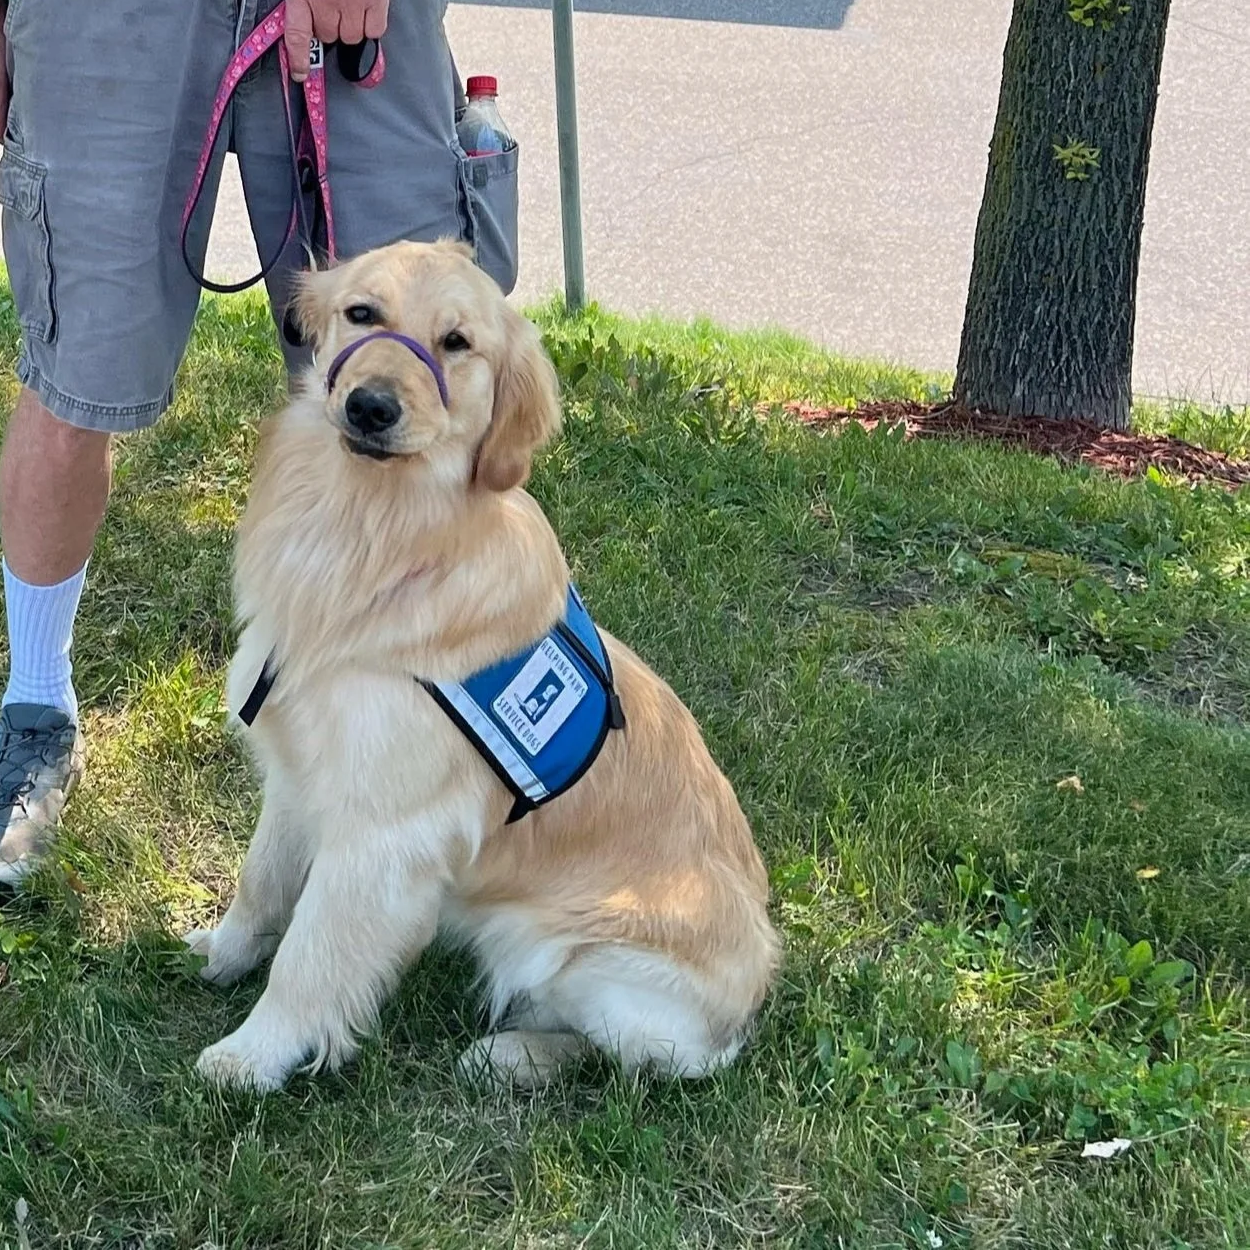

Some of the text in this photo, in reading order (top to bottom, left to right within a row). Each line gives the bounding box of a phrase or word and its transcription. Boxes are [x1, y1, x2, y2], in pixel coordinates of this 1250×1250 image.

[540, 640, 586, 698] HELPING PAWS
[496, 697, 542, 751] SERVICE DOGS
